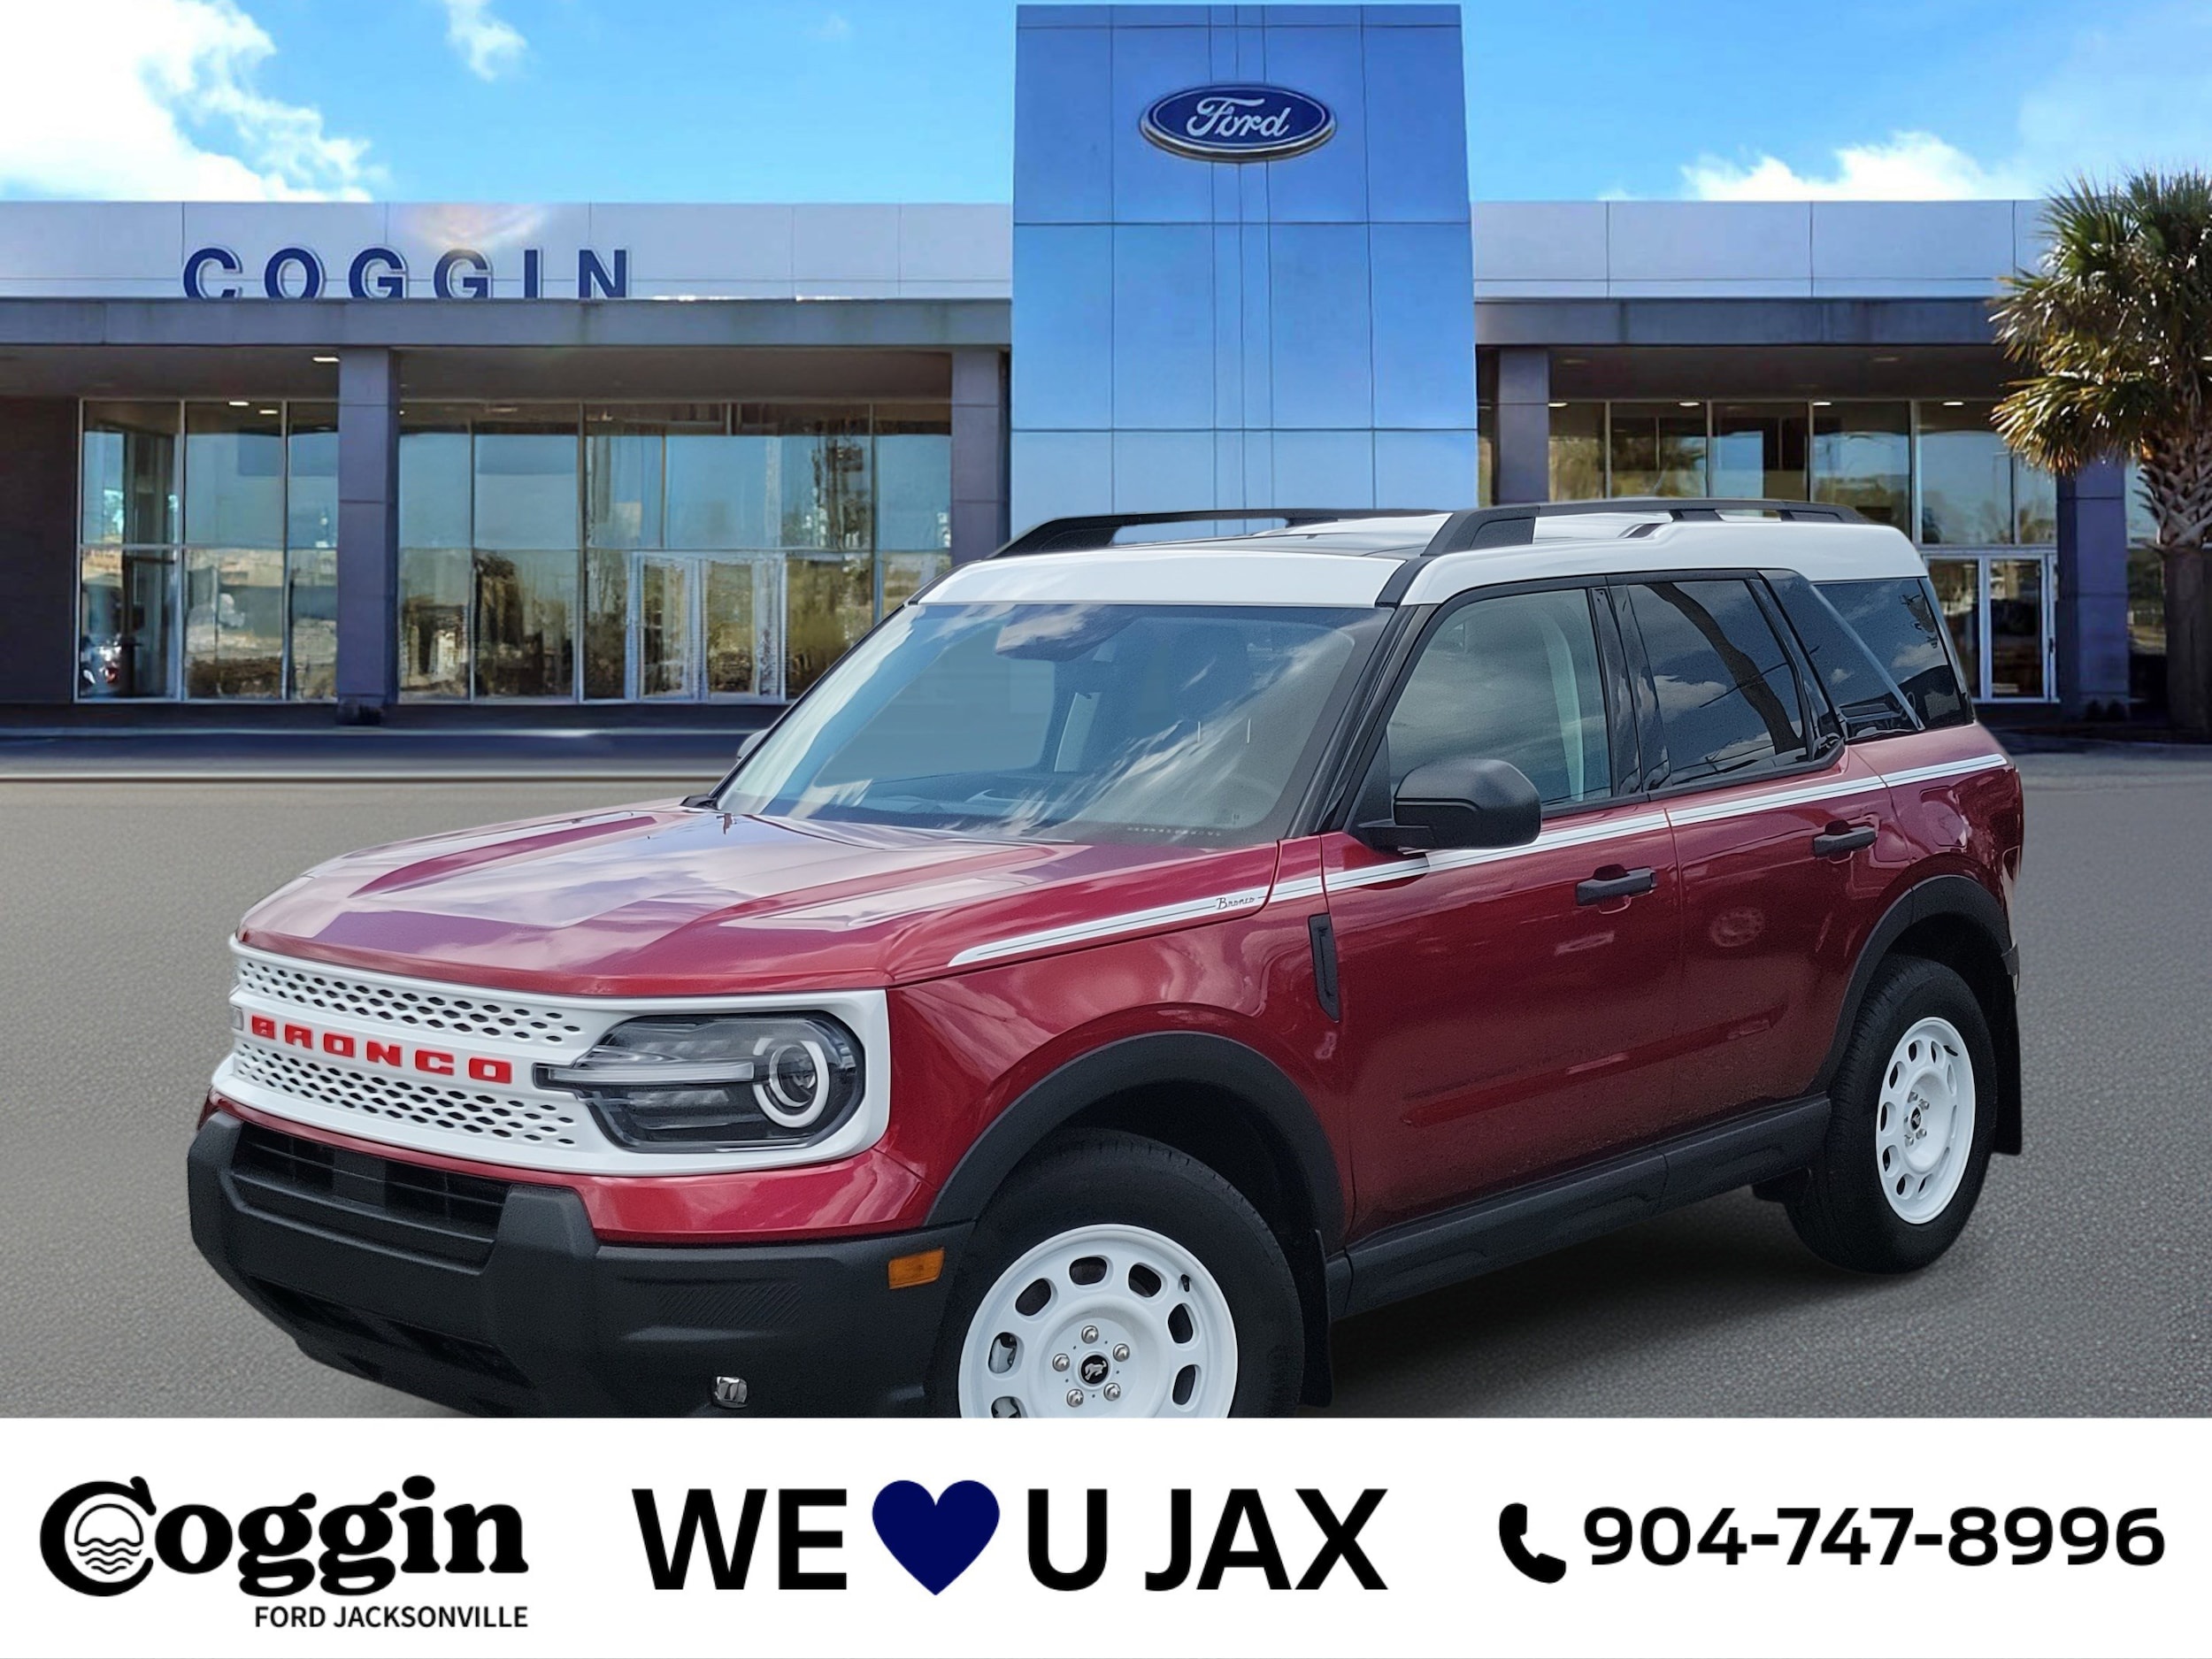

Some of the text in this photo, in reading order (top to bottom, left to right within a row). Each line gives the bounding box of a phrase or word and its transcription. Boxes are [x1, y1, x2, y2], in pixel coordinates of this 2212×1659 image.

[1187, 96, 1292, 137] Ford
[183, 248, 627, 298] COGGIN
[1216, 896, 1256, 910] Bronco
[251, 1014, 512, 1085] BRONCO
